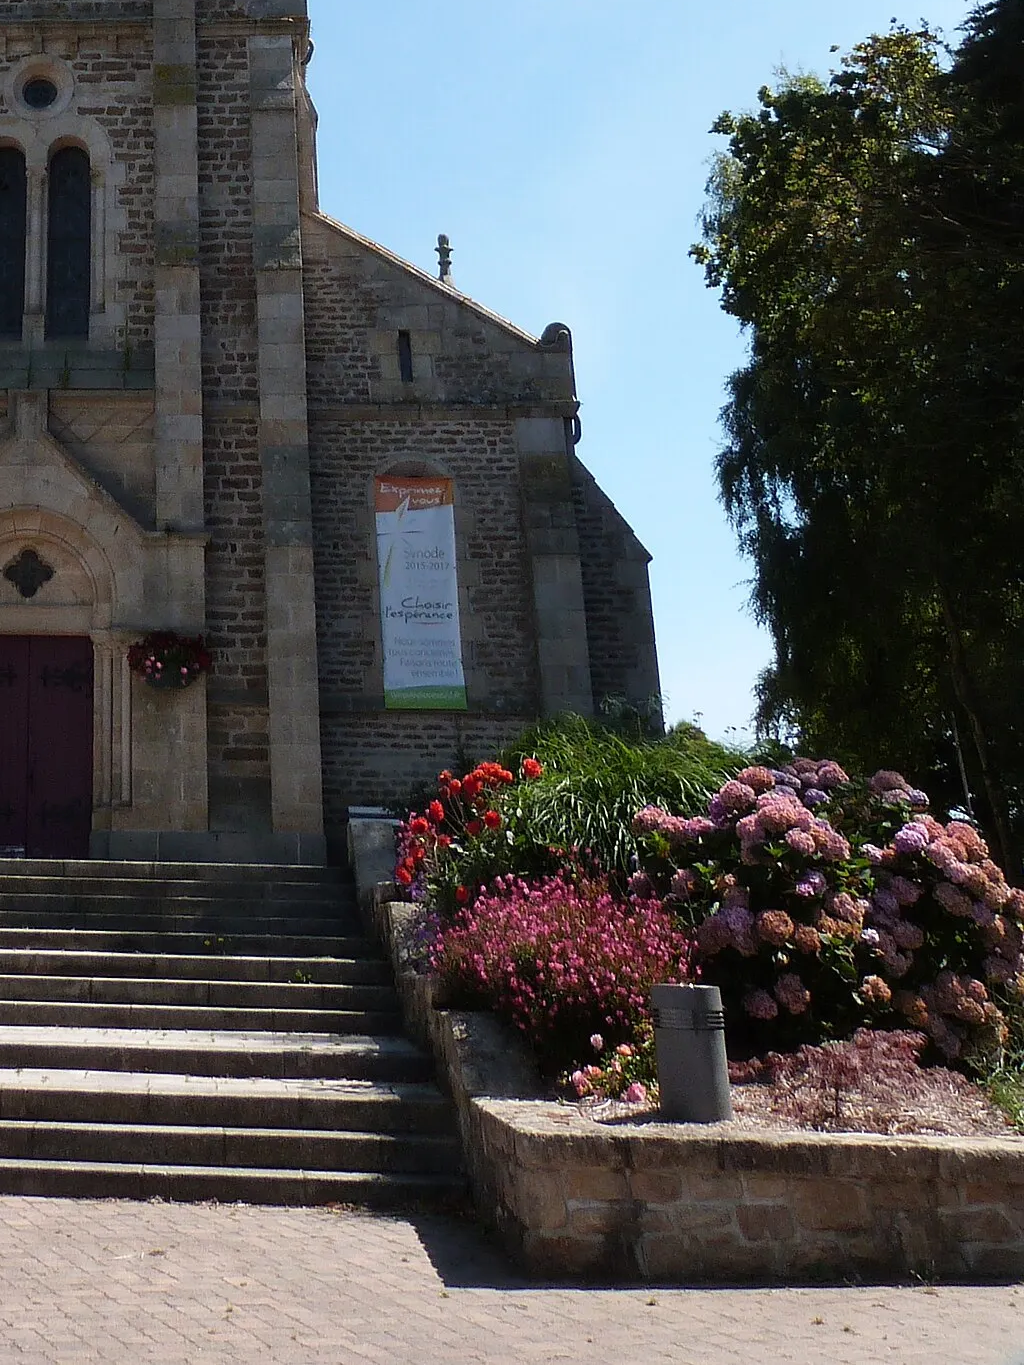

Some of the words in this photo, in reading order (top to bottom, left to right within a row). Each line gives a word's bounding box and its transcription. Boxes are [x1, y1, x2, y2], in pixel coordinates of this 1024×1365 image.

[405, 561, 450, 570] 2015-2017
[401, 596, 453, 609] Choisir
[385, 606, 453, 624] l'espérance
